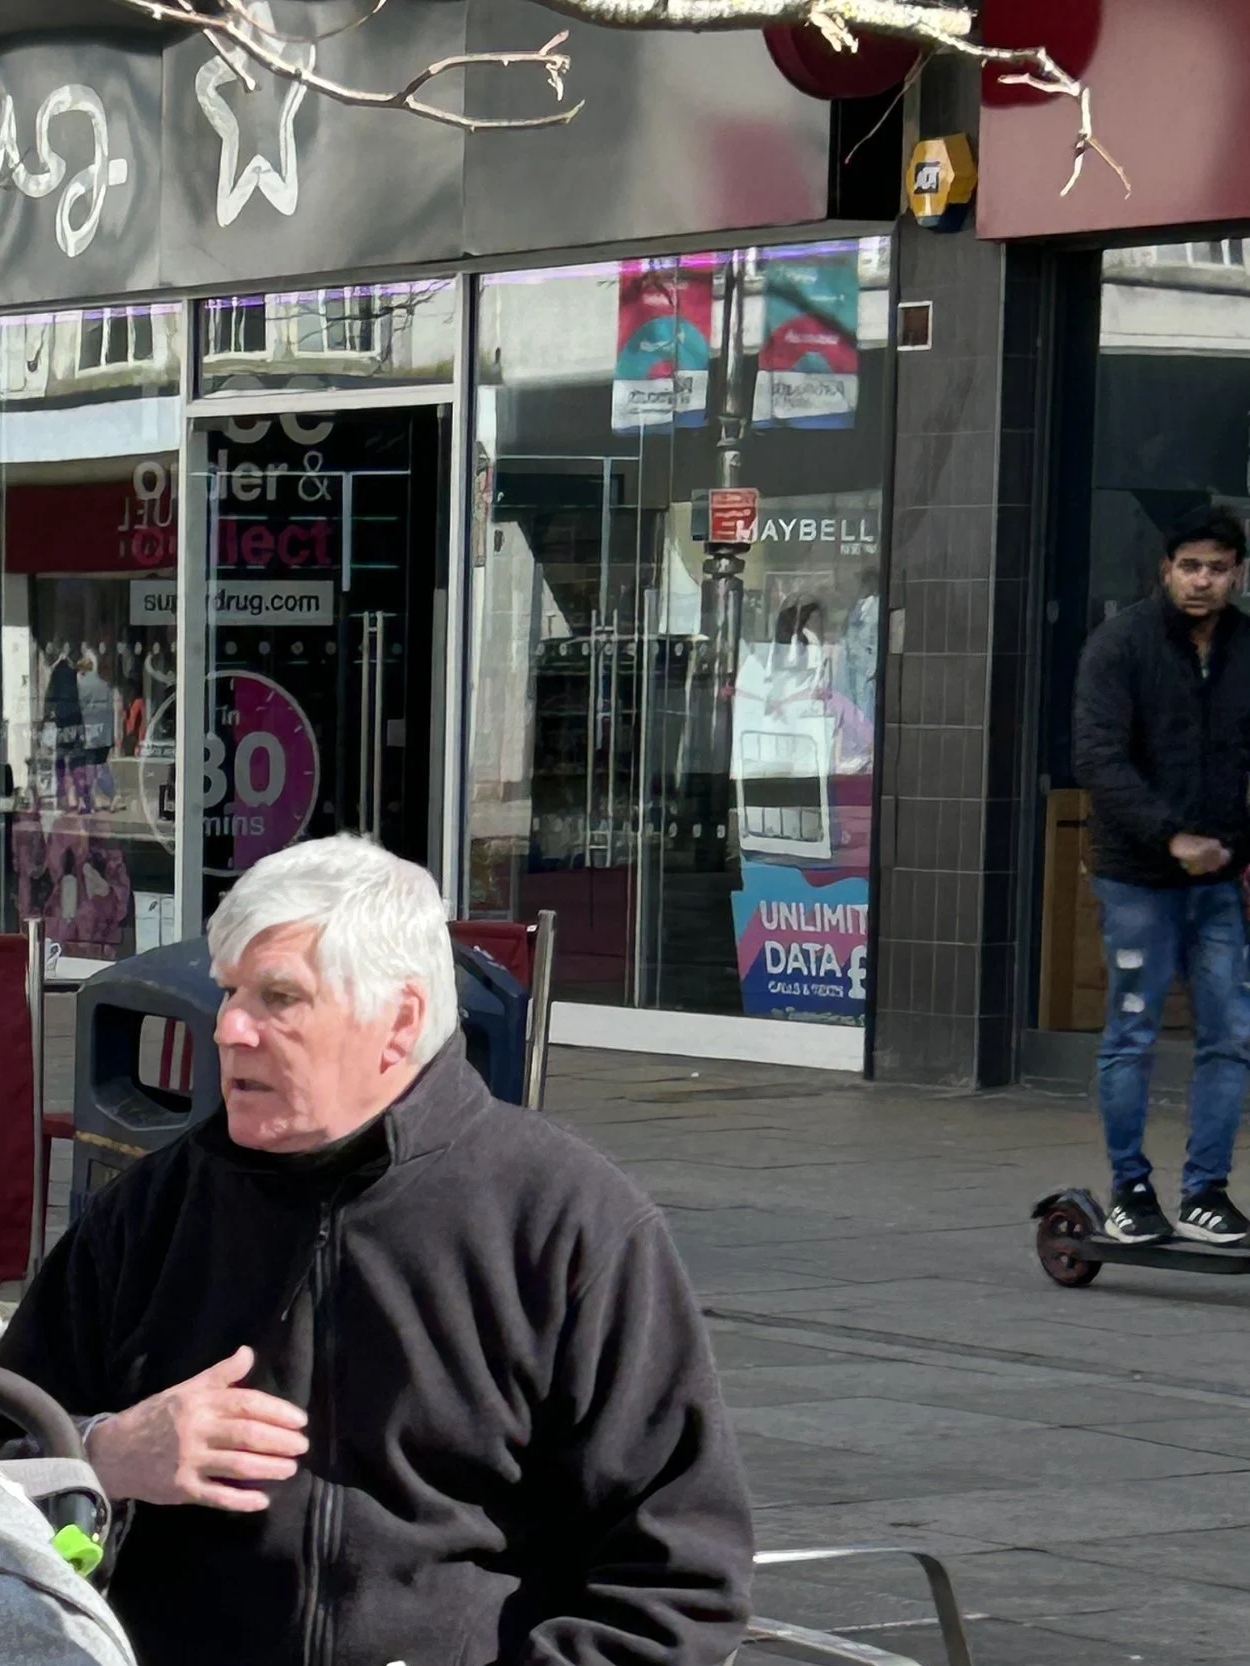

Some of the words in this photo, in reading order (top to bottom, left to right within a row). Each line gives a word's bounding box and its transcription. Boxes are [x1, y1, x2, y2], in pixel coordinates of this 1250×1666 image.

[133, 449, 288, 501] oer
[297, 451, 332, 501] &
[735, 517, 875, 543] MAYBELL
[143, 589, 320, 615] sudrug.com
[759, 900, 868, 935] UNLIMIT
[764, 940, 842, 978] DATA
